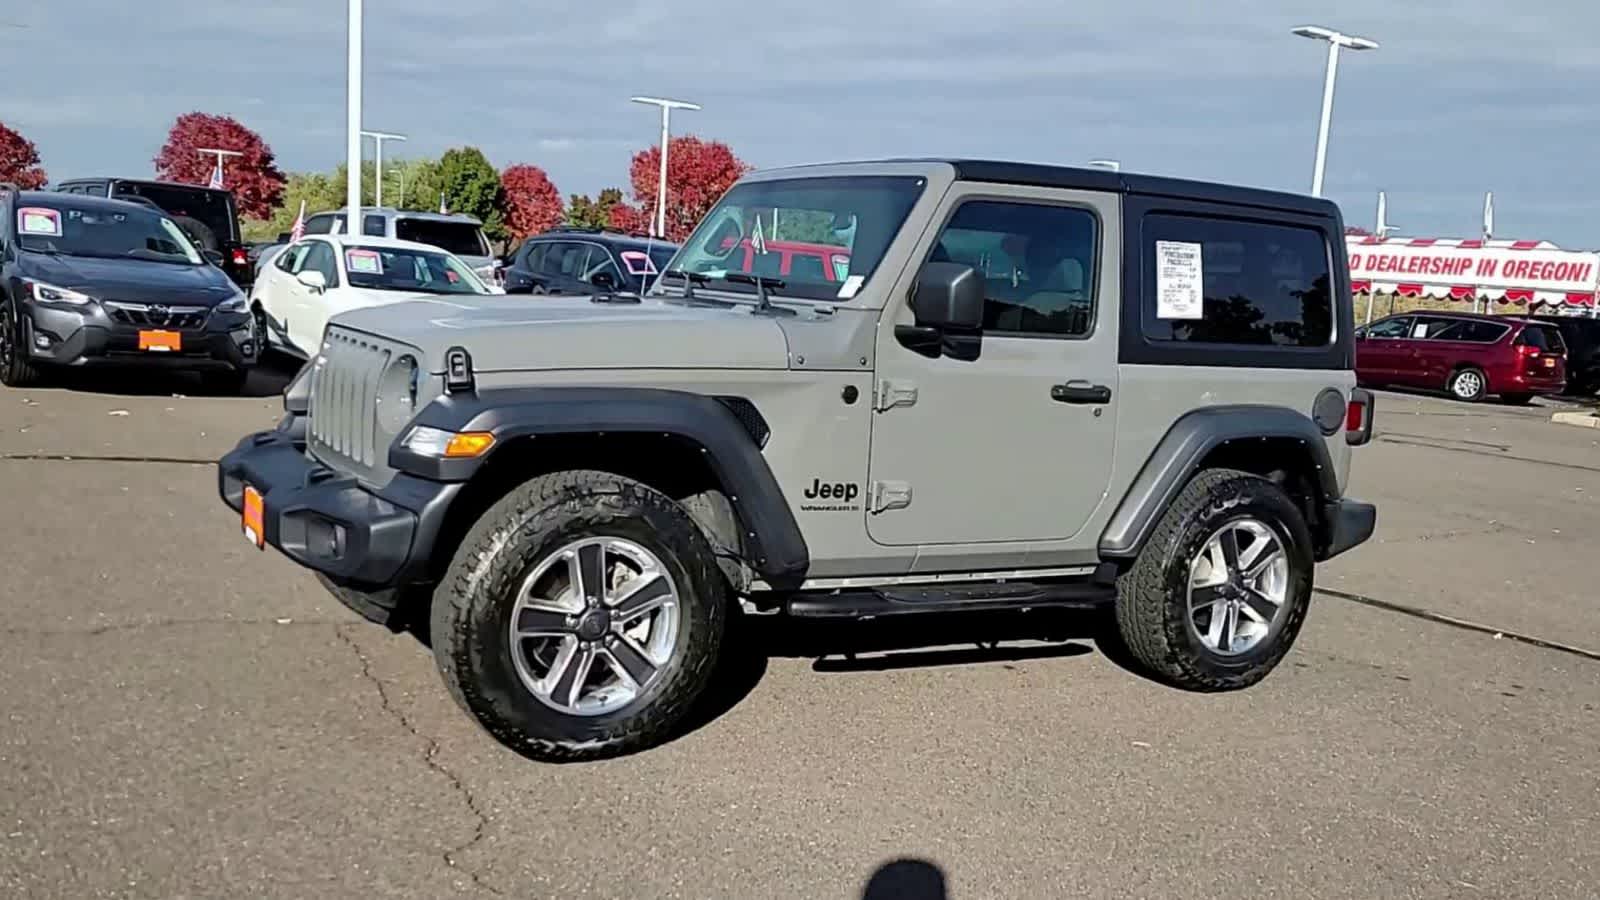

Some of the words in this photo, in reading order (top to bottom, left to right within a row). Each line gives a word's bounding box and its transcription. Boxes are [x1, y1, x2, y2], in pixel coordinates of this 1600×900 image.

[1365, 254, 1473, 276] DEALERSHIP
[1476, 259, 1498, 277] IN
[1502, 259, 1593, 282] OREGON!
[804, 478, 858, 502] Jeep
